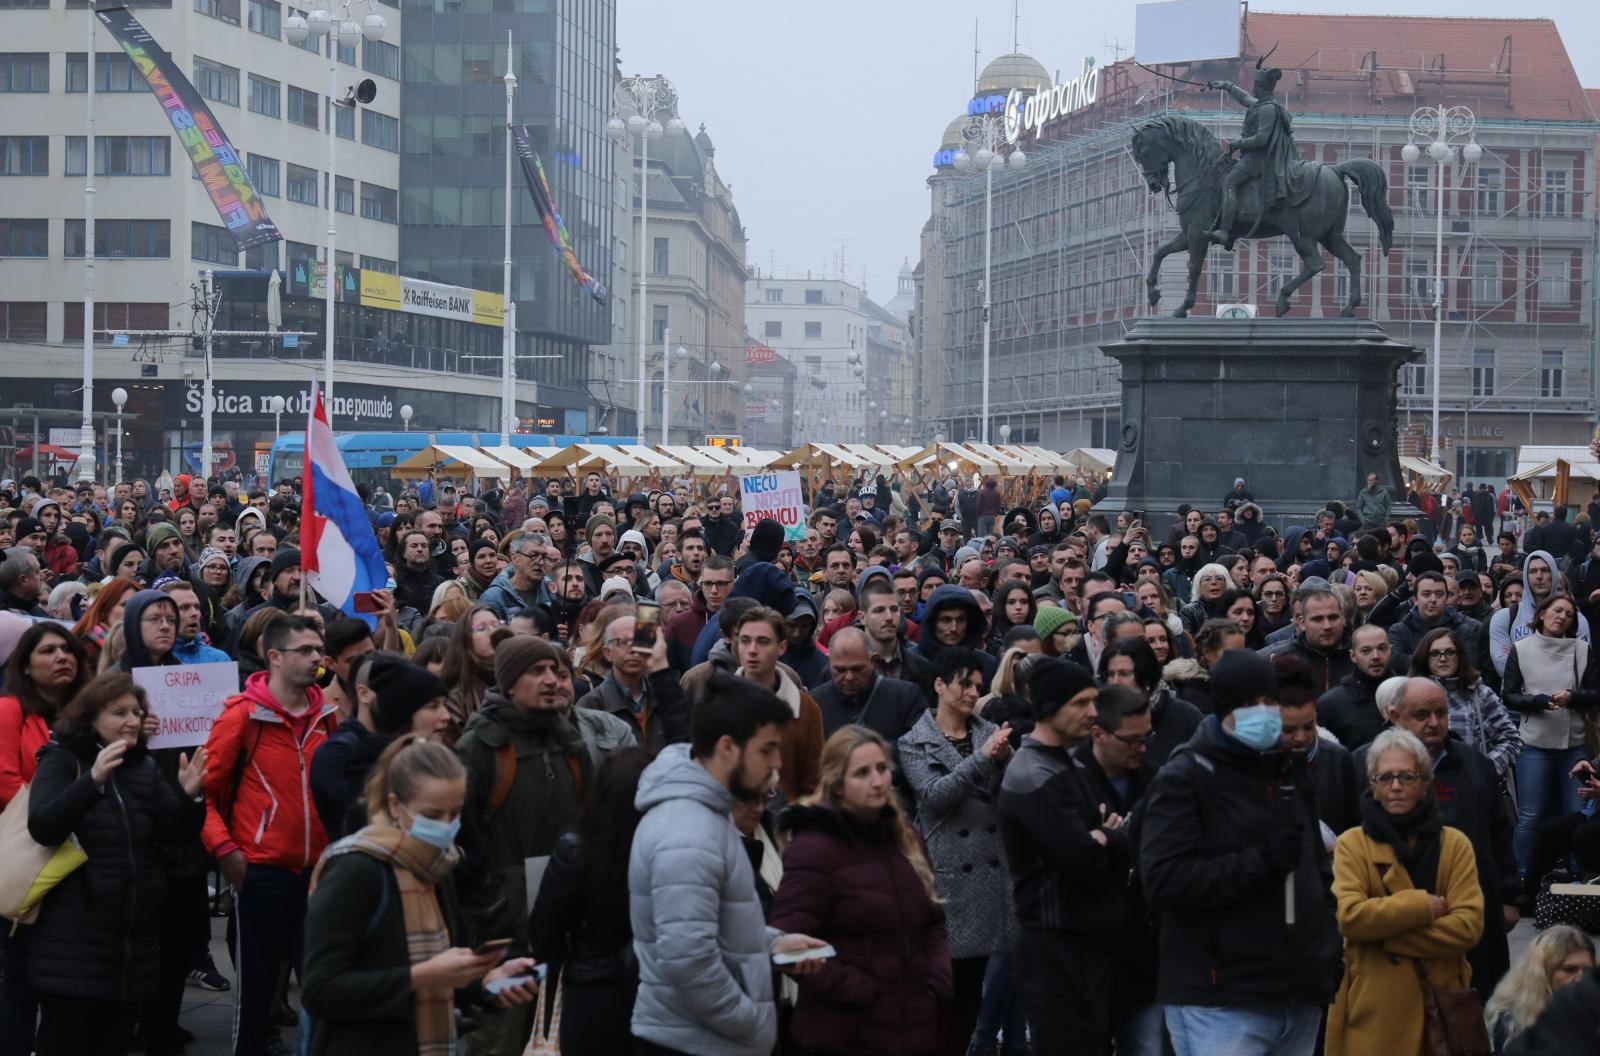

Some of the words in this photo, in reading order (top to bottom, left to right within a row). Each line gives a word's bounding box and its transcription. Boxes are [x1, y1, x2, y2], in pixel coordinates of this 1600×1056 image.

[411, 289, 448, 310] Raiffeisen
[449, 296, 470, 315] BANK
[354, 396, 393, 421] ponude
[754, 487, 801, 508] NOSITI
[164, 671, 202, 687] GRIPA
